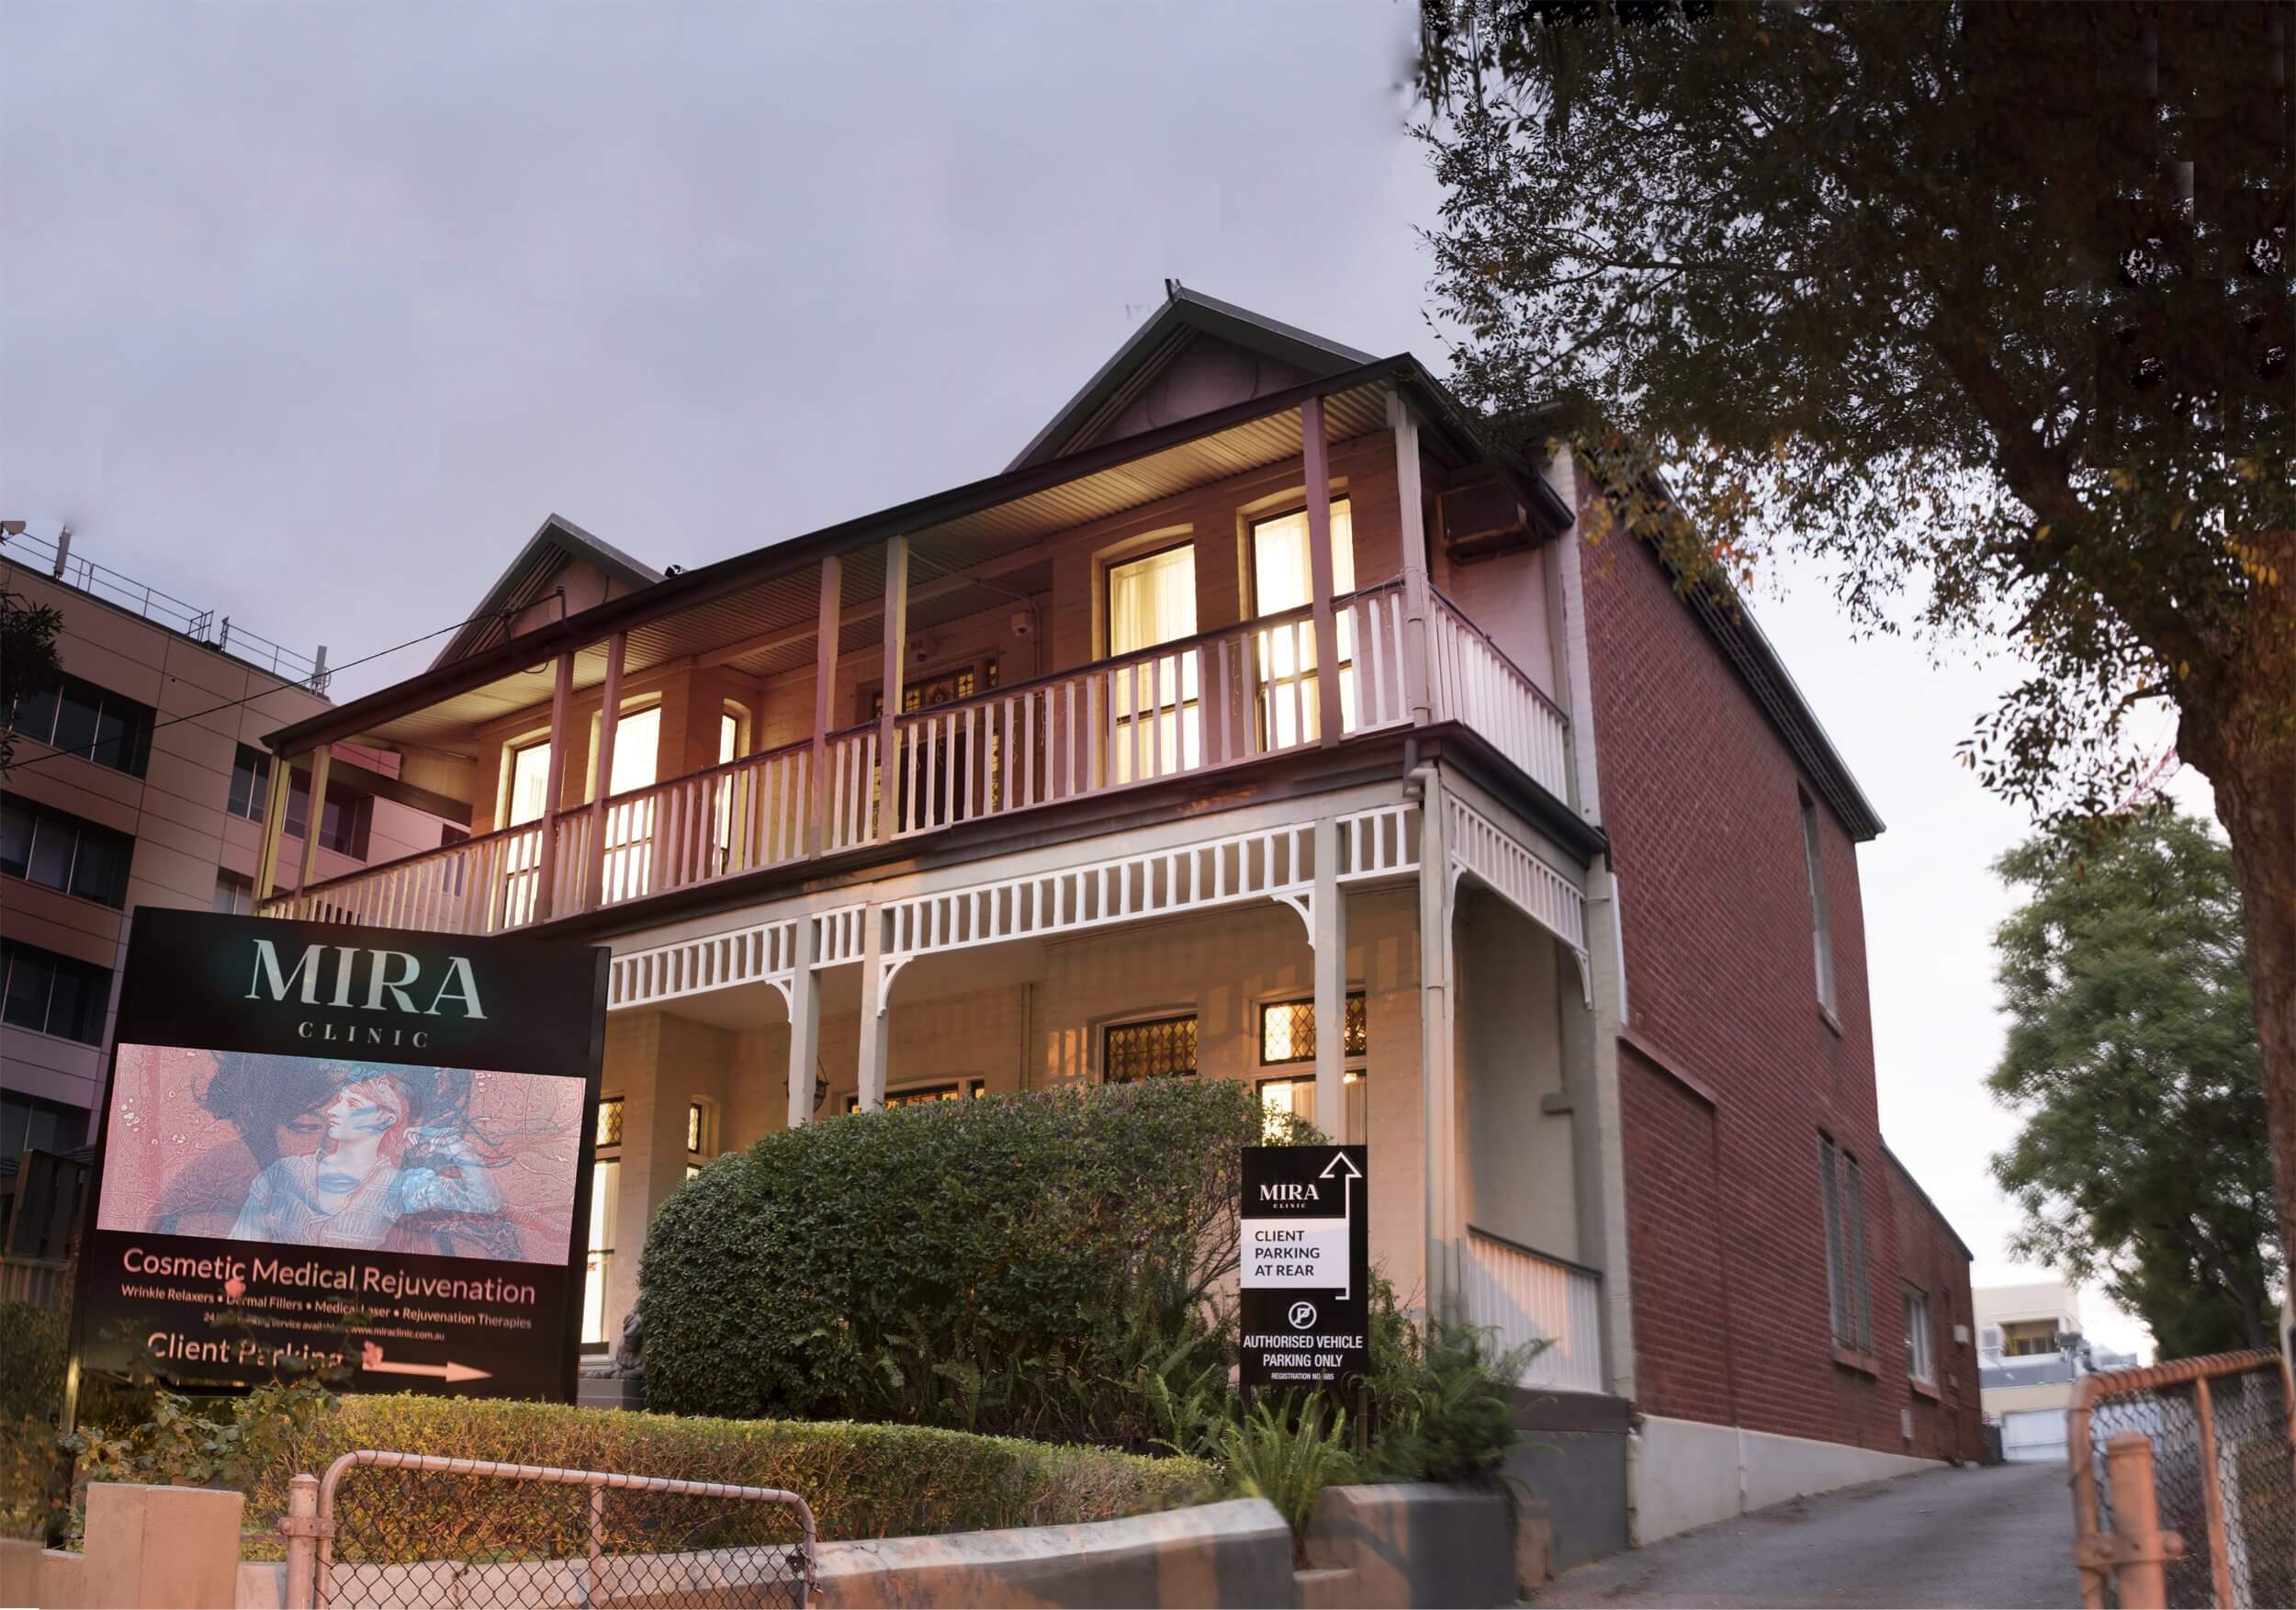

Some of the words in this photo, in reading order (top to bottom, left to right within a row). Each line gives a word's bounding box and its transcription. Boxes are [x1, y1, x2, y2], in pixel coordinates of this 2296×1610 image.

[244, 939, 489, 1019] MIRA
[298, 1020, 429, 1049] CLINIC
[1259, 1183, 1320, 1201] MIRA
[1255, 1230, 1305, 1242] CLIENT
[1255, 1247, 1321, 1259] PARKING
[123, 1247, 246, 1281] Cosmetic
[252, 1256, 356, 1291] Medical
[363, 1266, 536, 1305] Rejuvenation
[1255, 1265, 1274, 1277] AT
[1276, 1265, 1314, 1277] REAR
[121, 1283, 165, 1300] Wrinkle
[167, 1287, 215, 1304] Relaxers
[269, 1295, 303, 1312] Fillers
[314, 1300, 358, 1315] Medica
[402, 1307, 476, 1325] Rejuvenation
[478, 1312, 532, 1330] Therapies
[147, 1332, 231, 1364] Client
[1243, 1335, 1314, 1349] AUTHORISED
[1316, 1335, 1364, 1349] VEHICLE
[1263, 1354, 1311, 1368] PARKING
[1314, 1354, 1344, 1368] ONLY
[1271, 1372, 1311, 1380] REGISTRATION
